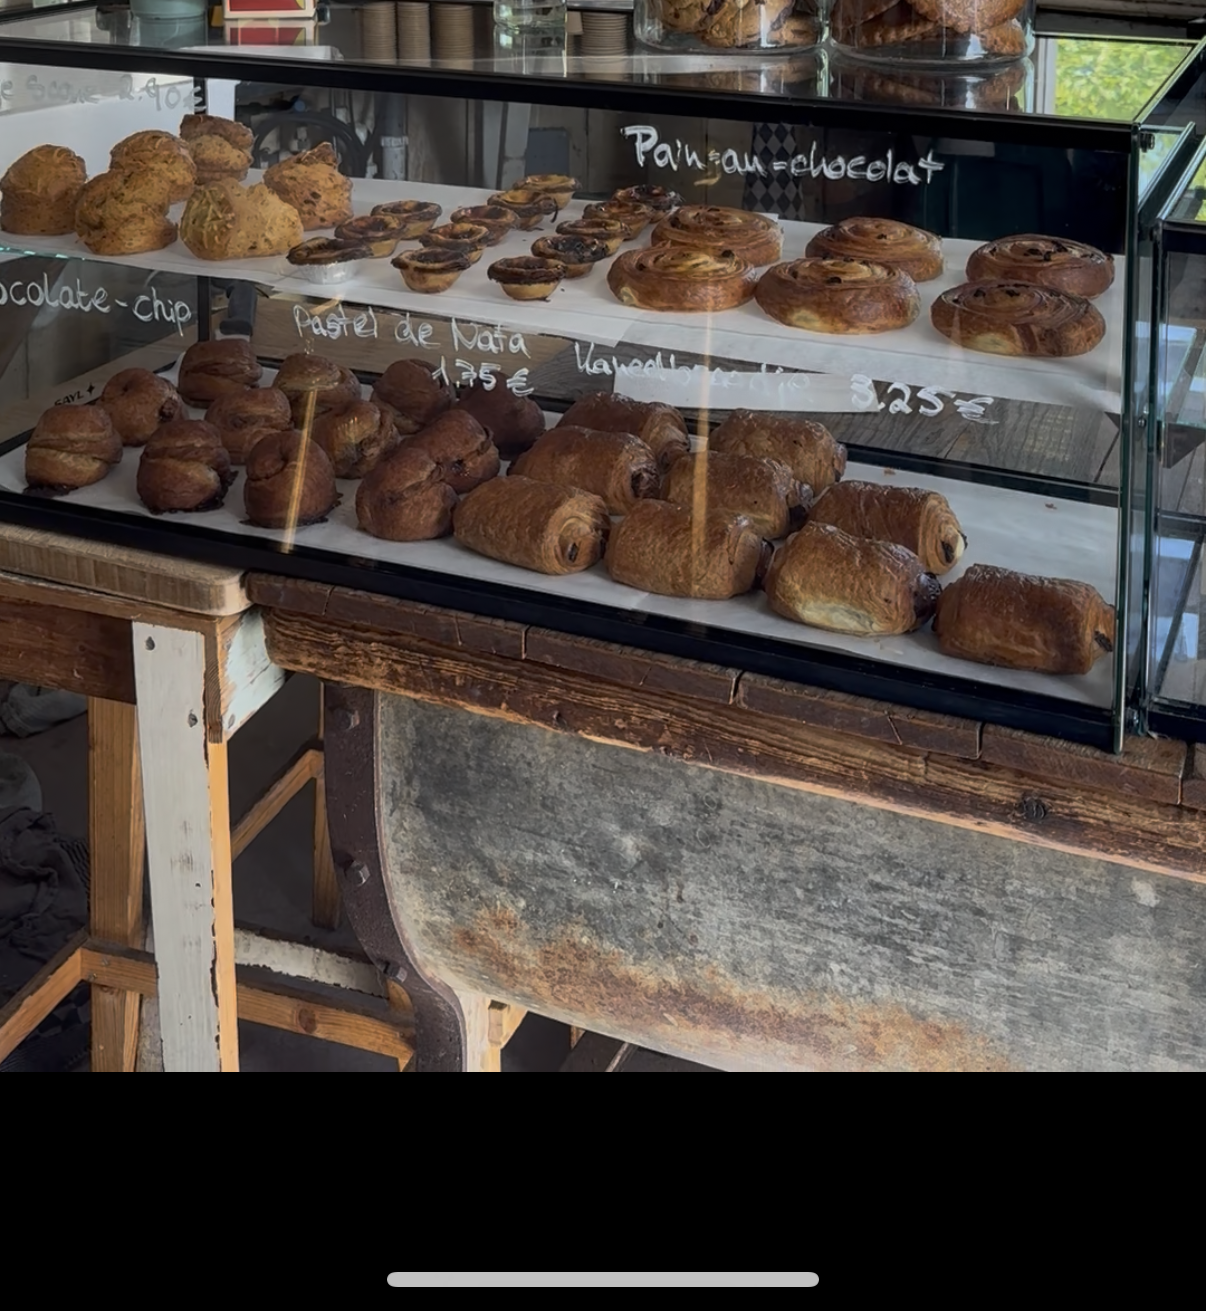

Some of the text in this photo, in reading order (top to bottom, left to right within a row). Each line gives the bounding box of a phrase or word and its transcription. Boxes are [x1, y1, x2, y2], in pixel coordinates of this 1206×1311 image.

[293, 304, 531, 359] Pastel de Nata
